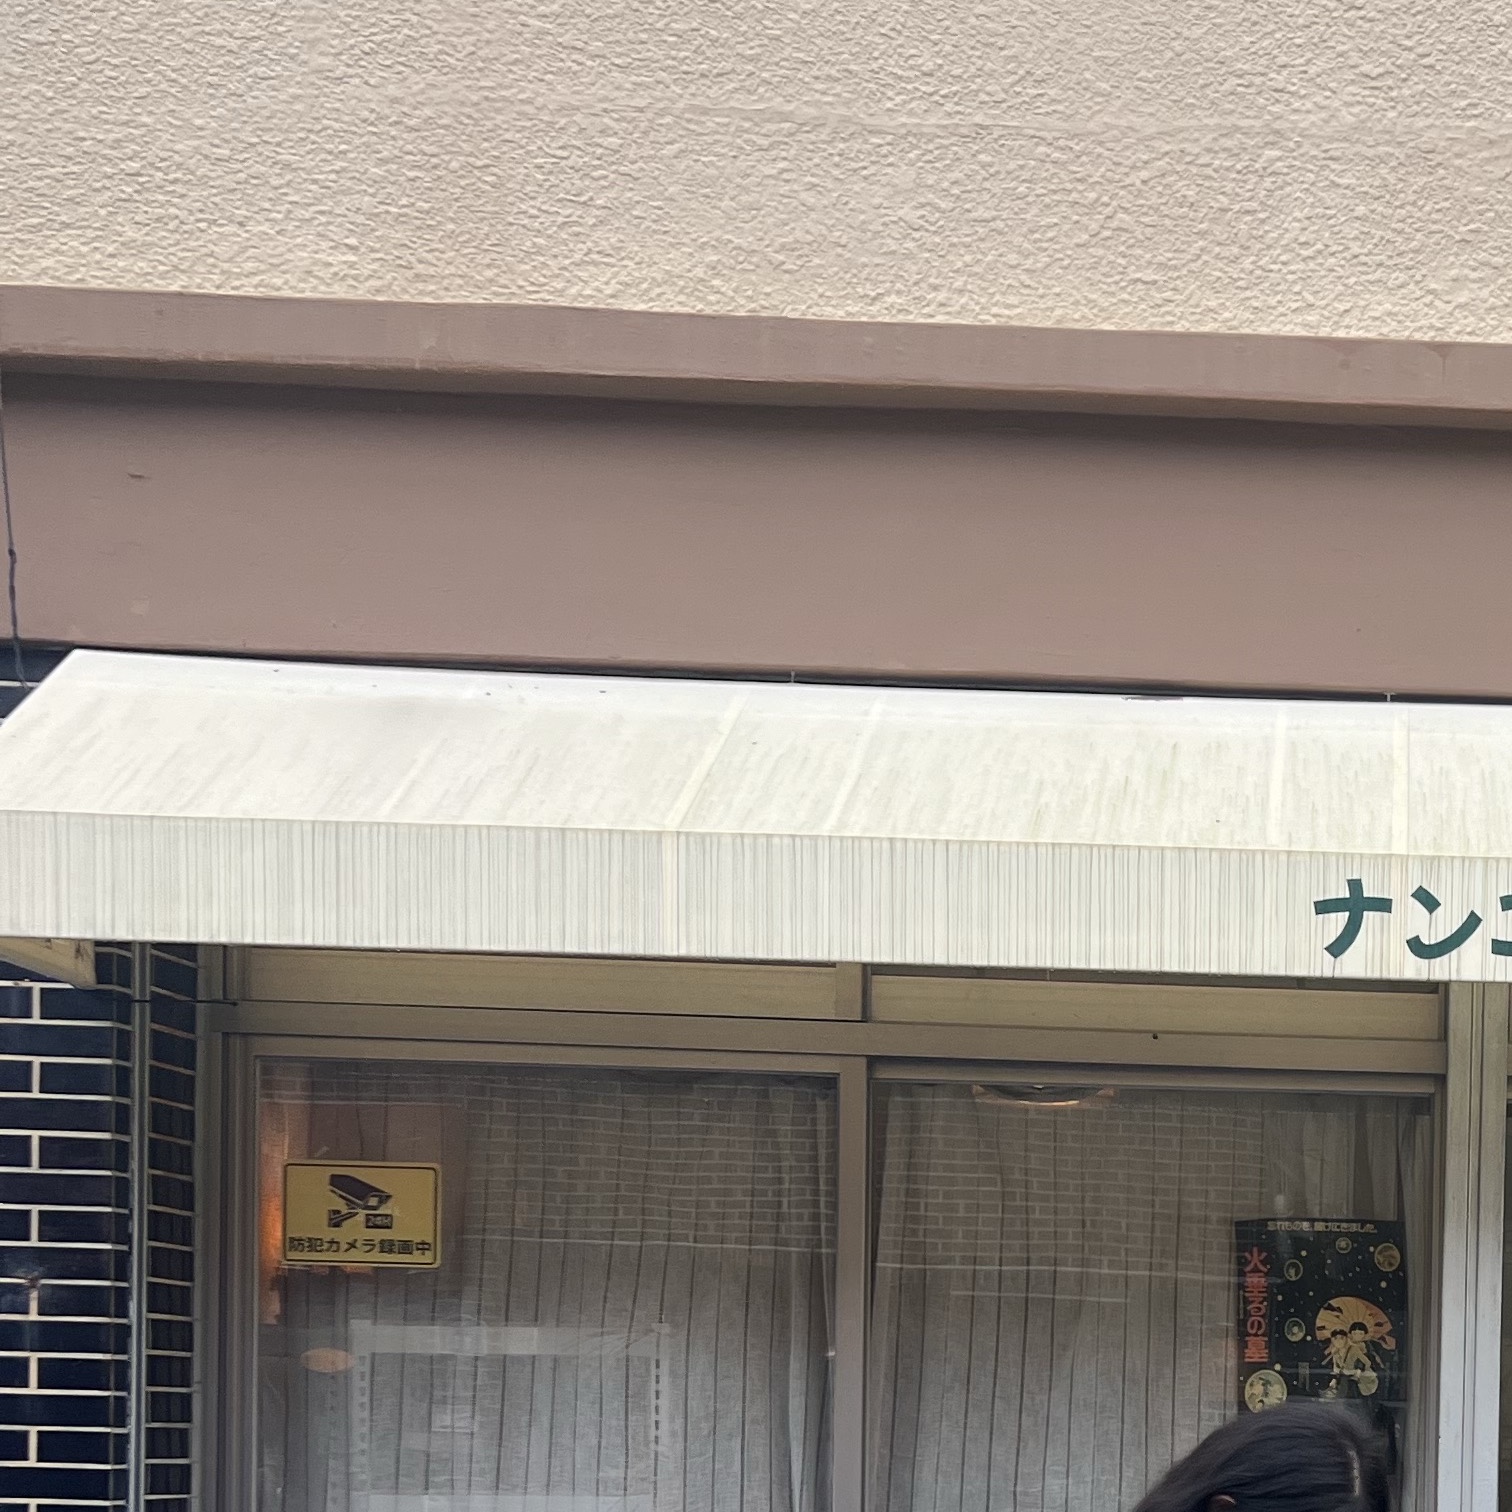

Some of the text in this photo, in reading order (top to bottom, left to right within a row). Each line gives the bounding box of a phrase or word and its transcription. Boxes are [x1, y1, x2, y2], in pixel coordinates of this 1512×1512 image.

[288, 1237, 432, 1256] 防犯カメラ録画中
[1244, 1246, 1268, 1363] 火垂るの墓
